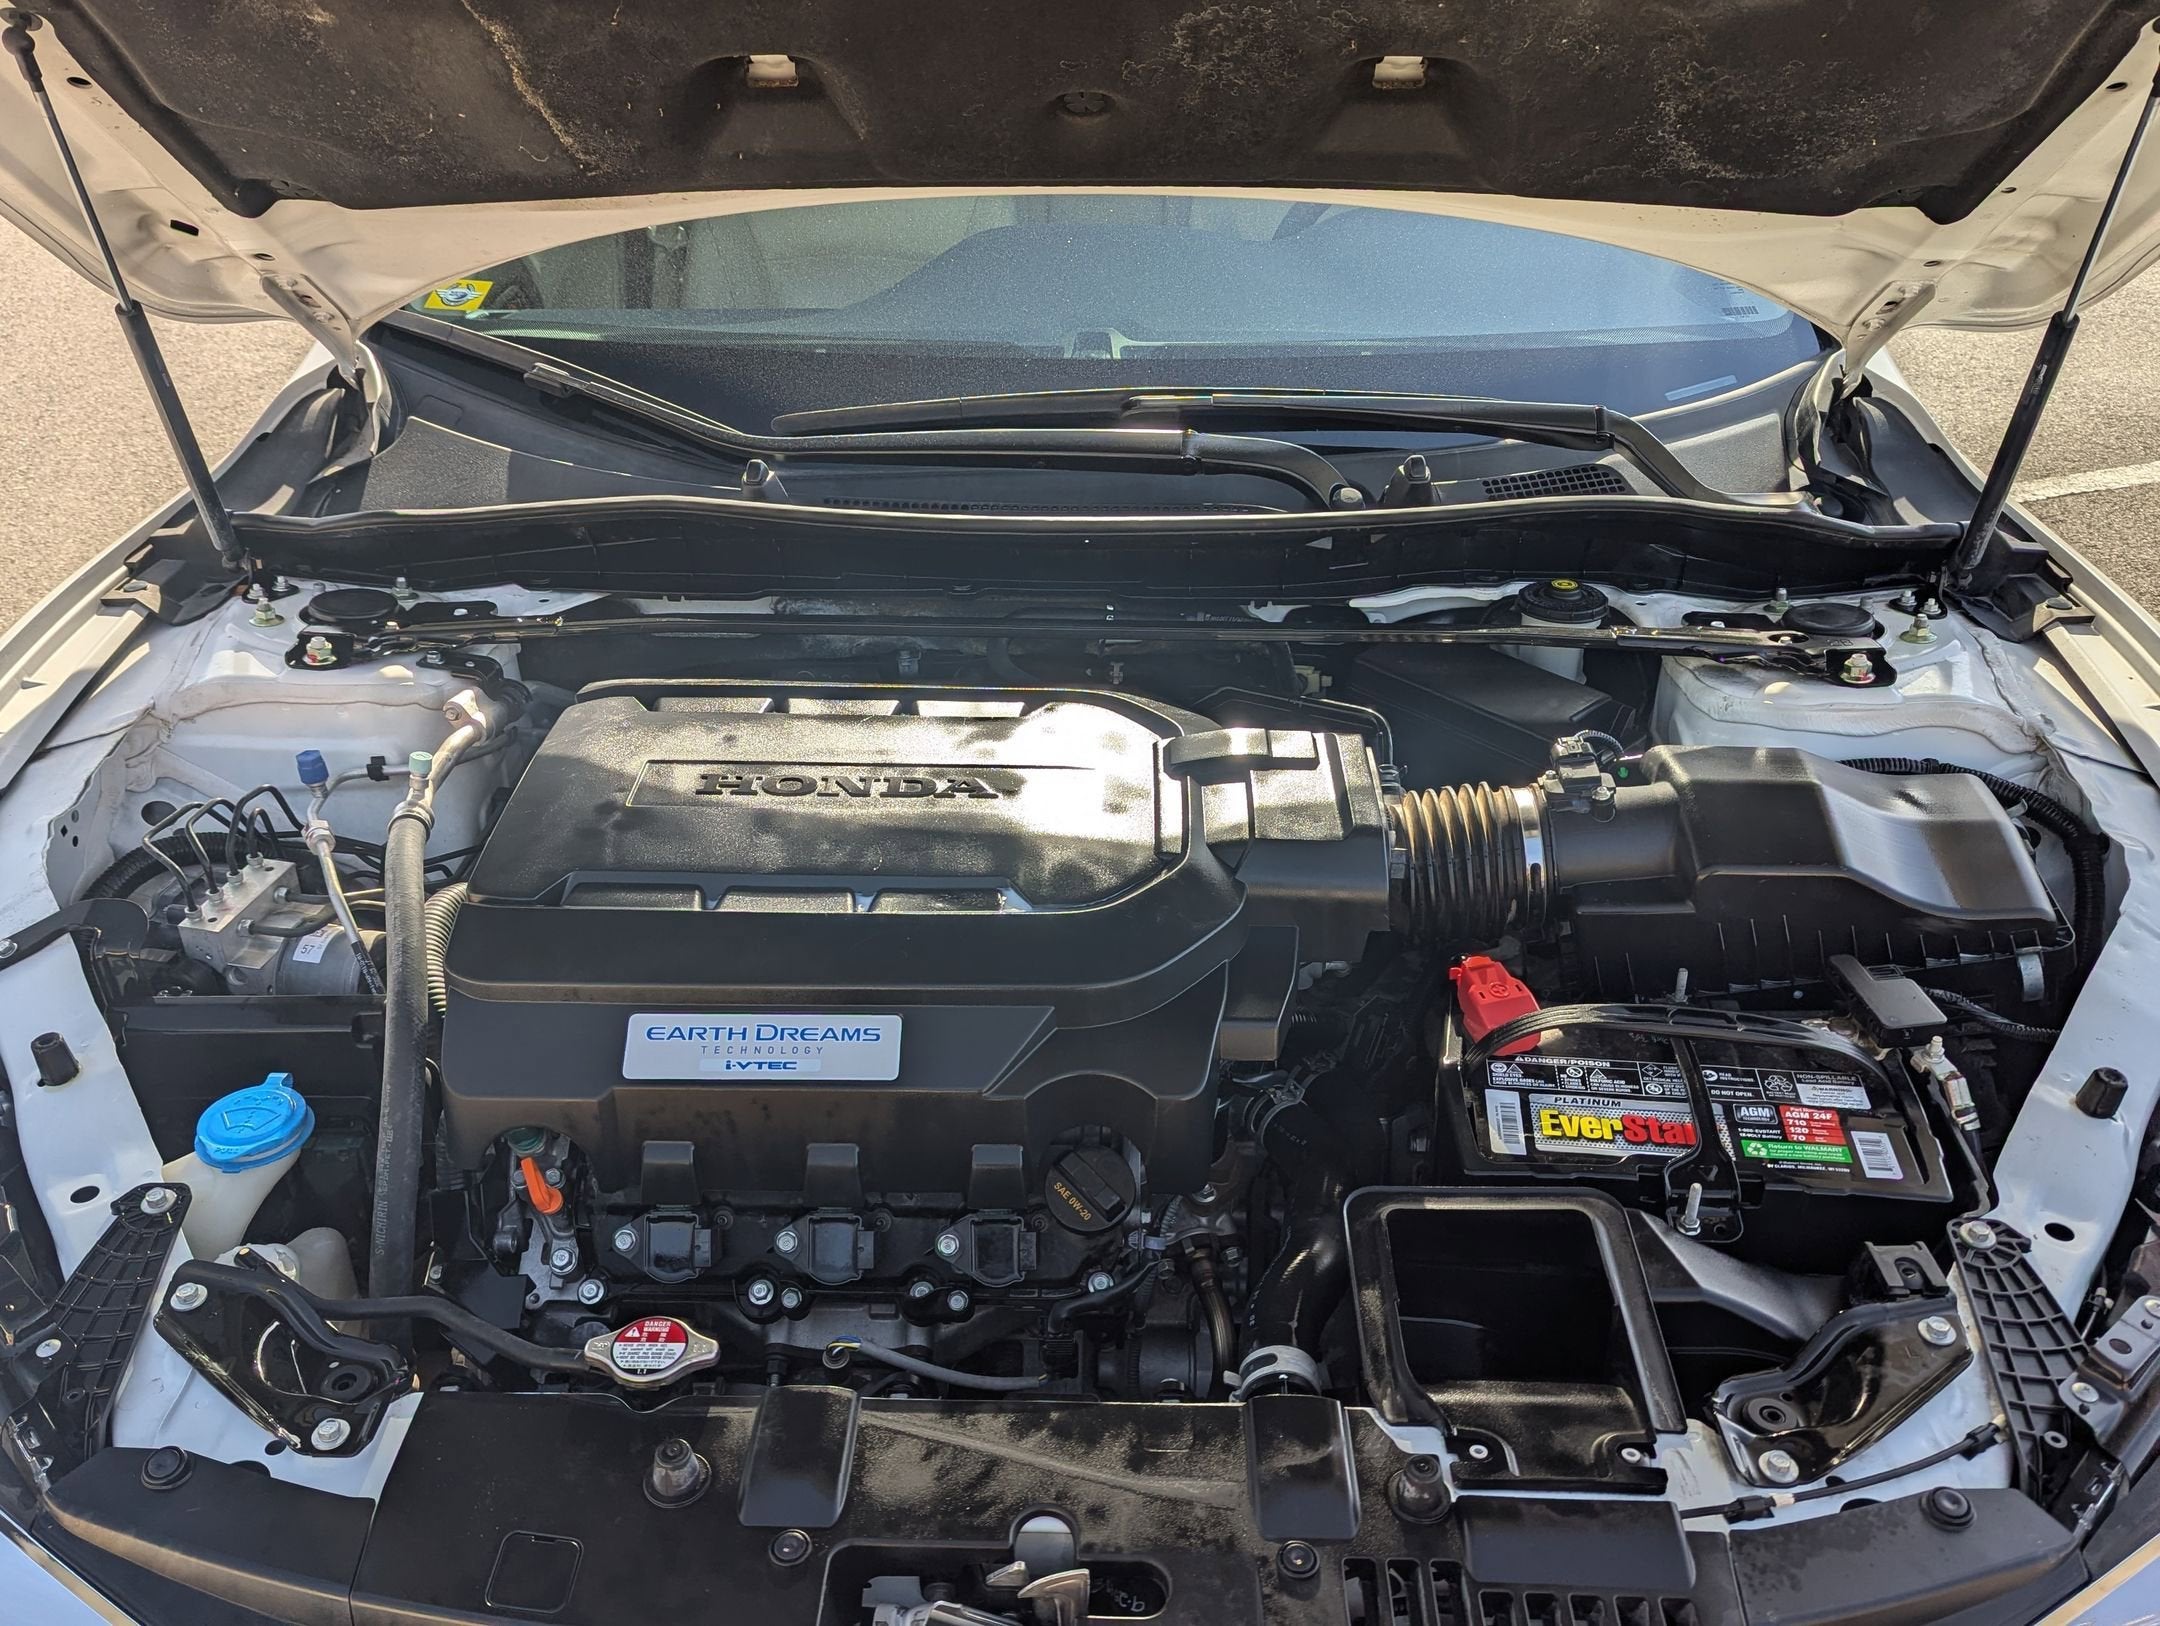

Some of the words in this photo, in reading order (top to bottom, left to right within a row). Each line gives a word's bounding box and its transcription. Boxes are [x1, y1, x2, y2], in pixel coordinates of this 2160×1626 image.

[695, 773, 999, 799] HONDA
[300, 944, 316, 955] 57
[646, 1026, 748, 1042] EARTH
[755, 1024, 882, 1042] DREAMS
[700, 1045, 824, 1055] TECHNOLOGY
[725, 1060, 798, 1071] i-VTEC
[1524, 1056, 1610, 1067] DANGER/POISON
[1554, 1096, 1622, 1108] PLATINUM
[1741, 1106, 1770, 1118] AGM
[1790, 1126, 1809, 1134] 120
[1053, 1181, 1072, 1200] SAE
[1068, 1196, 1092, 1221] 0W-20
